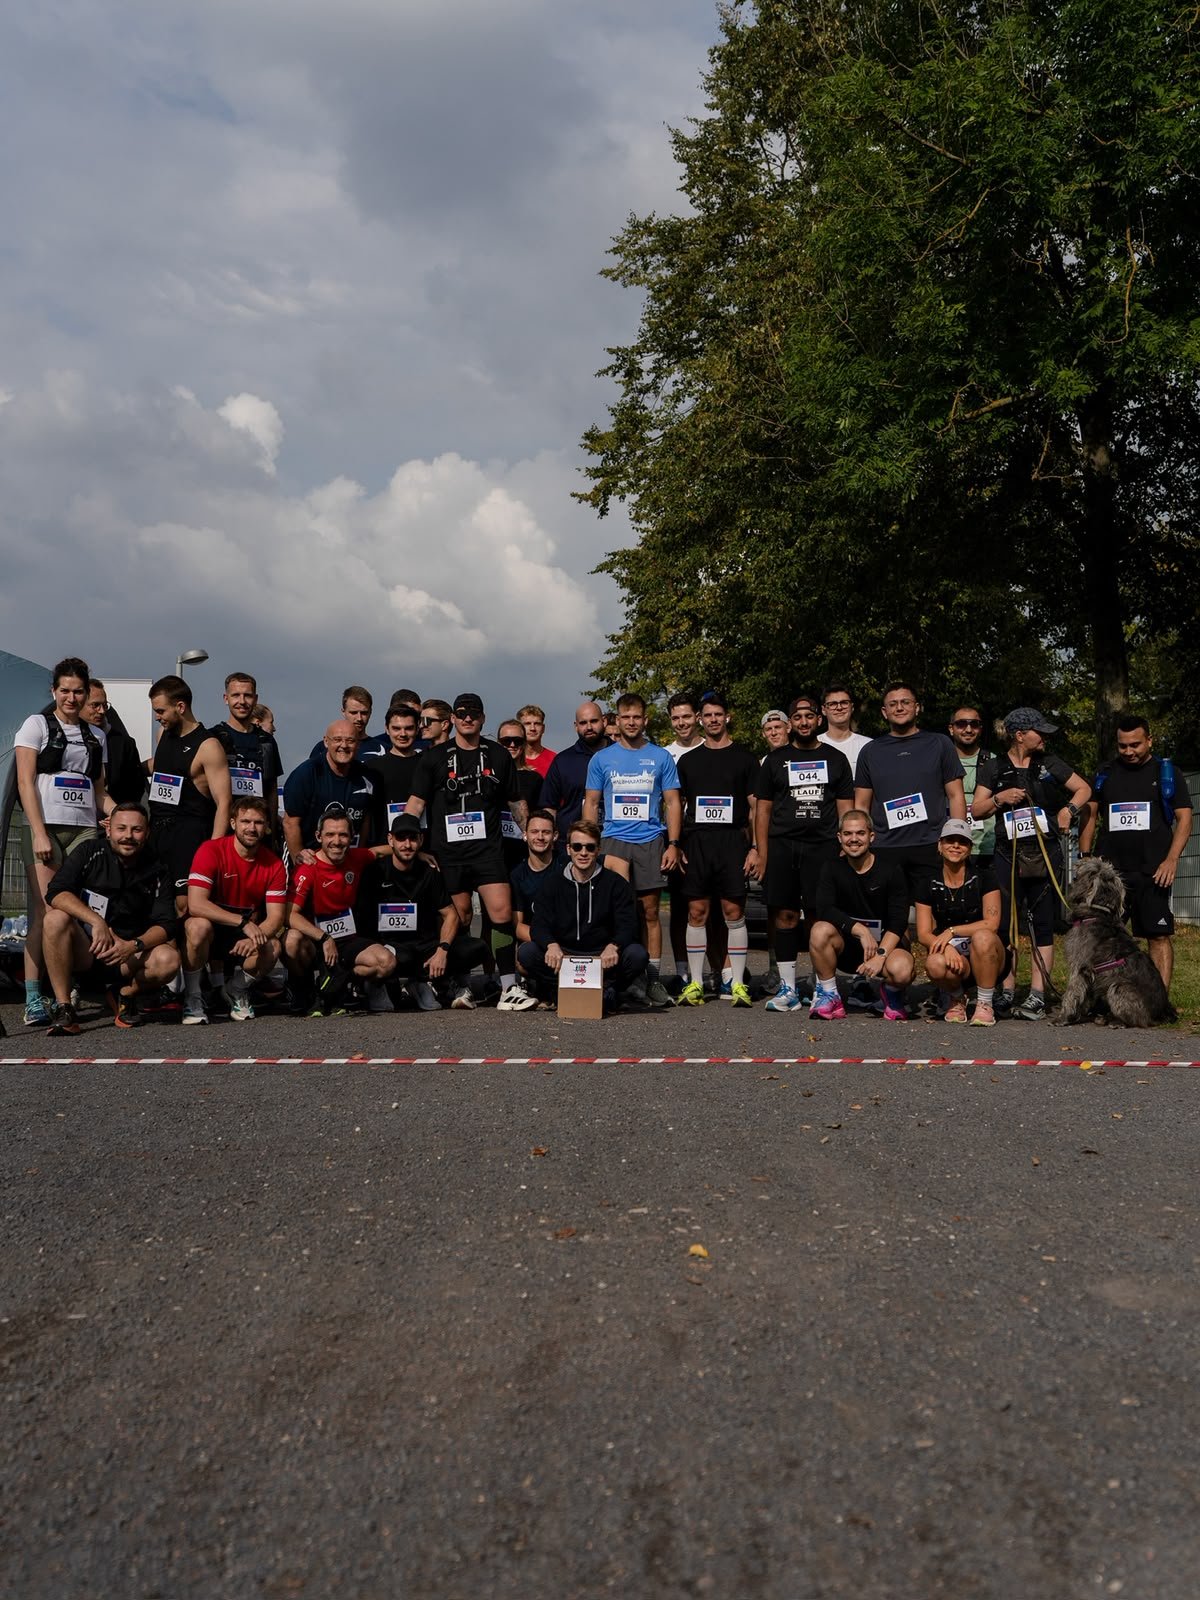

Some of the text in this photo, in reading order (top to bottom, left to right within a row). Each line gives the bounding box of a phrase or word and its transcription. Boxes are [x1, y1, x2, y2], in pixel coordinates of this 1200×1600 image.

[799, 772, 818, 781] 044
[236, 780, 254, 791] 038
[63, 791, 84, 802] 004
[158, 787, 172, 798] 035
[622, 806, 639, 816] 019
[705, 809, 723, 818] 007
[896, 808, 916, 821] 043
[1120, 815, 1137, 825] 021
[457, 826, 475, 835] 001
[502, 823, 516, 833] 08
[1017, 821, 1036, 832] 025
[388, 917, 407, 926] 032
[326, 921, 346, 934] 002
